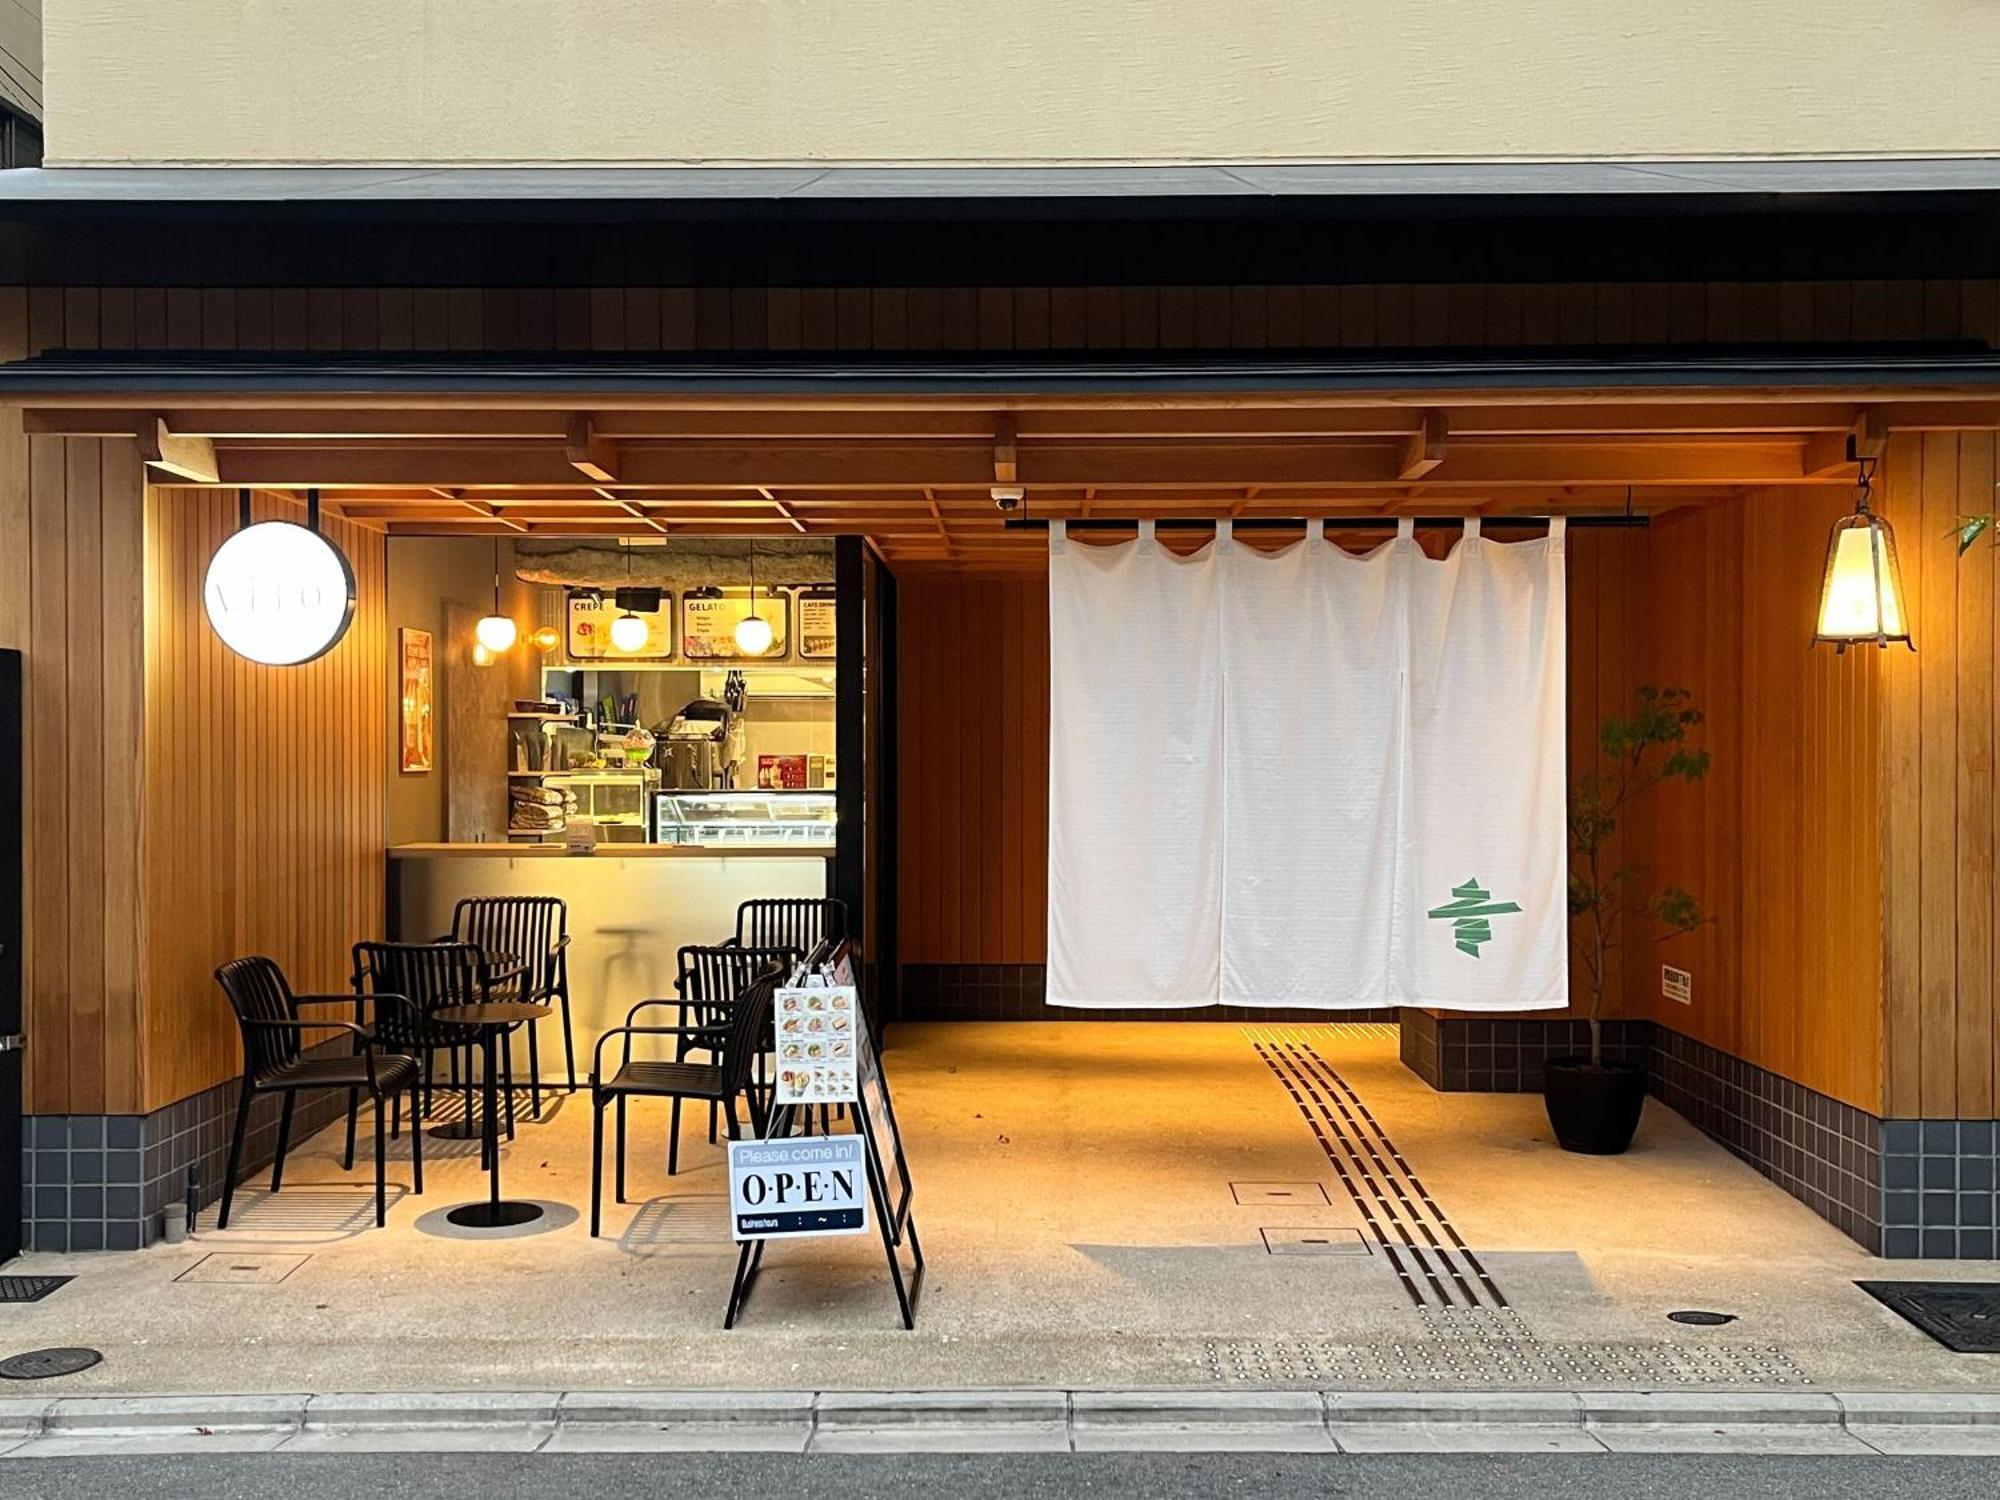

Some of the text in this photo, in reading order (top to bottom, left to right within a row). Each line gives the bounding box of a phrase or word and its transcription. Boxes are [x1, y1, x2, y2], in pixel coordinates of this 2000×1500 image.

[689, 602, 726, 611] GELATO
[740, 1149, 789, 1163] Please
[791, 1148, 833, 1160] come
